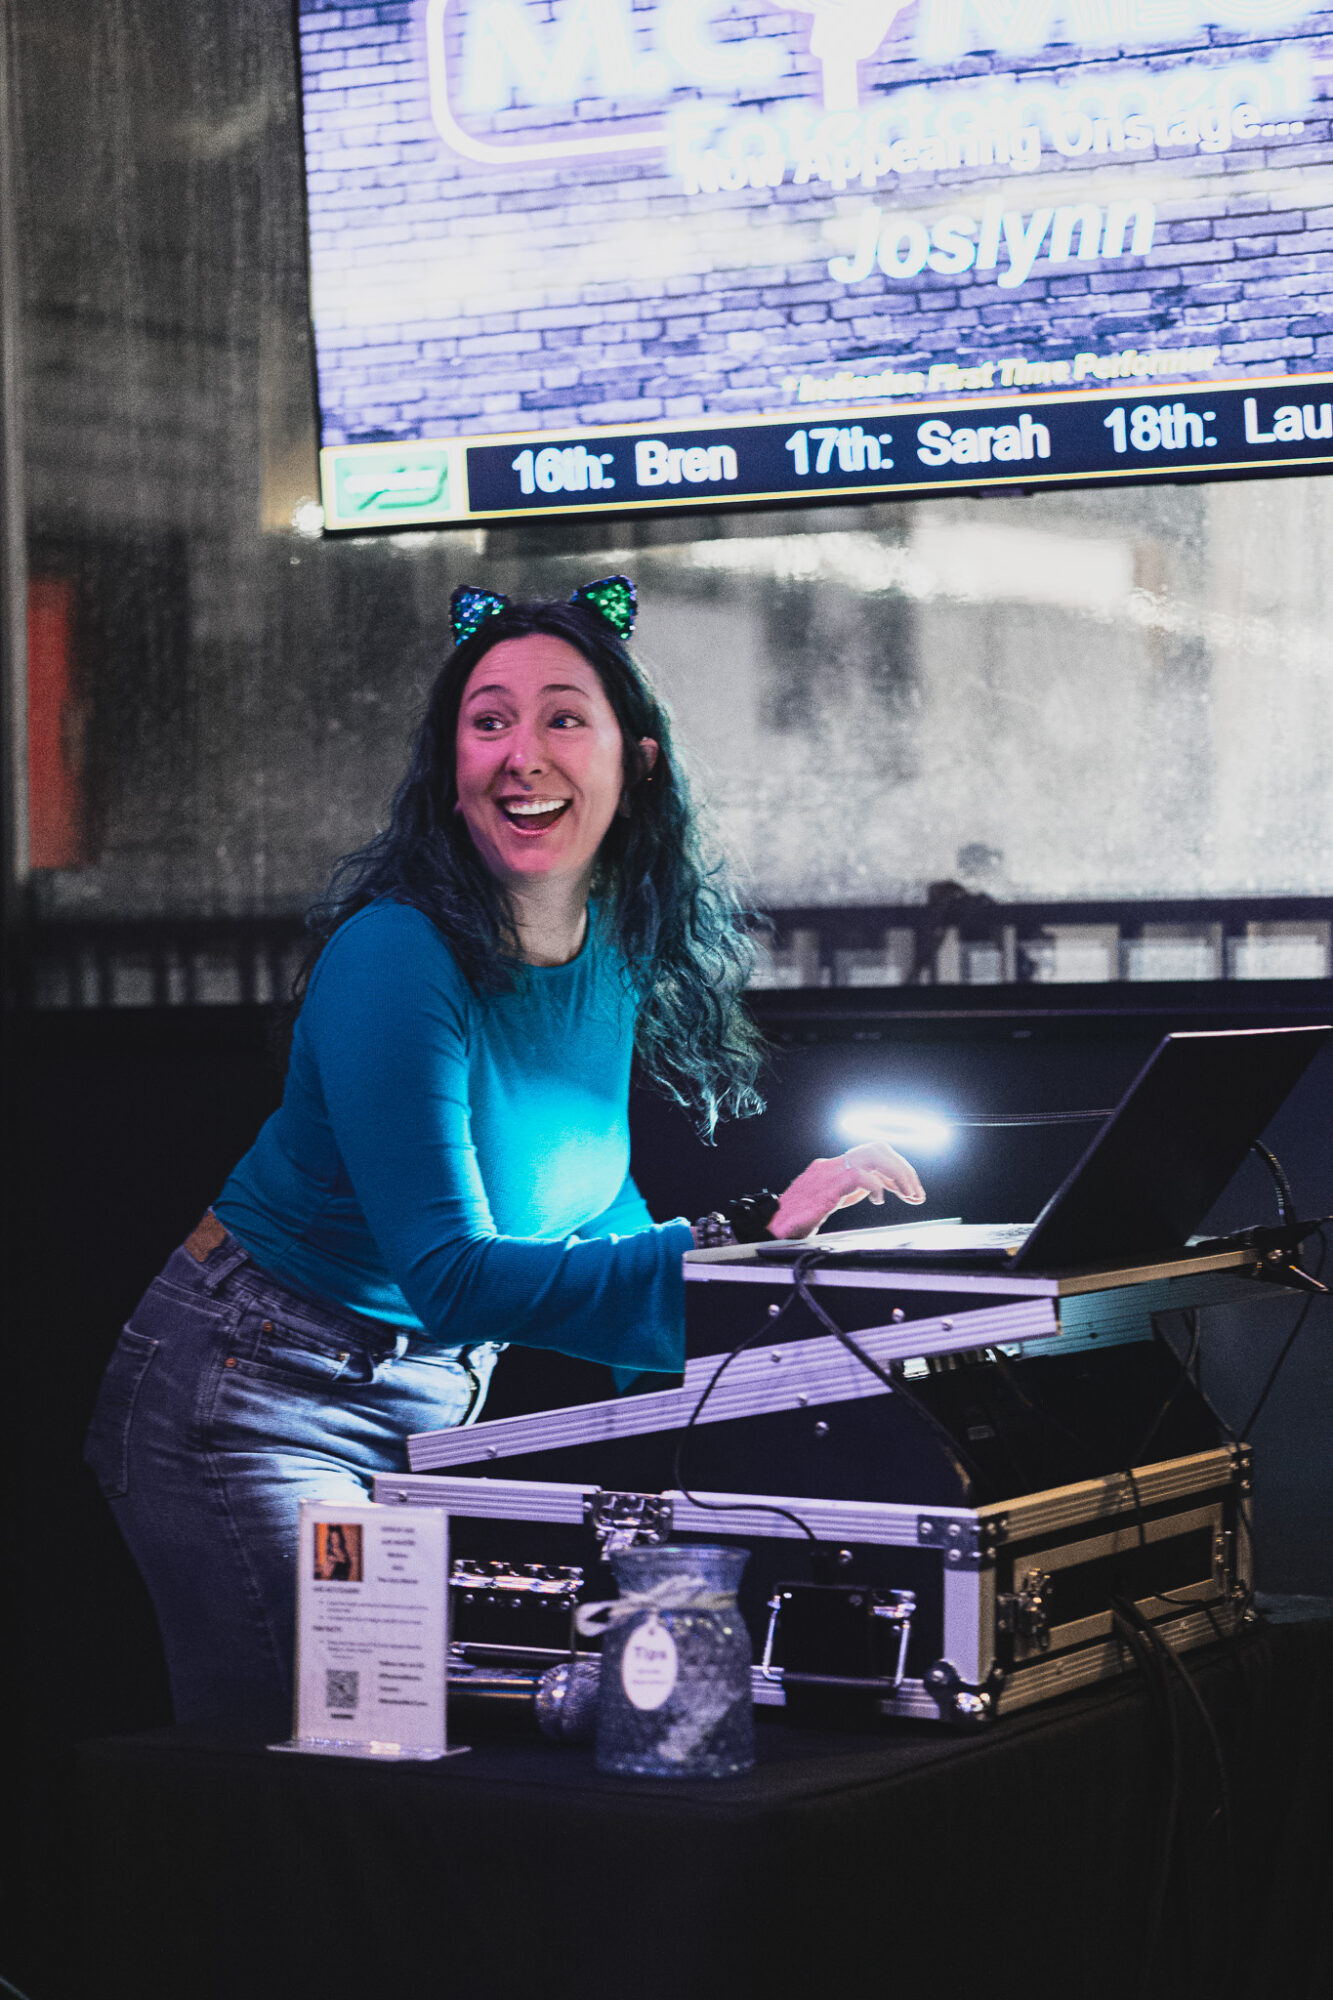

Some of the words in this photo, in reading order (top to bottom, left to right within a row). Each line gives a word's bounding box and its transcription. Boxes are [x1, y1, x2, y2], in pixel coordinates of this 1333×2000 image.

[794, 124, 1041, 190] Appearing
[828, 197, 1157, 289] Joslynn
[998, 357, 1070, 386] Time
[511, 446, 616, 495] 16th:
[634, 440, 739, 487] Bren
[785, 425, 894, 475] 17th:
[916, 413, 1051, 467] Sarah
[1103, 402, 1218, 454] 18th:
